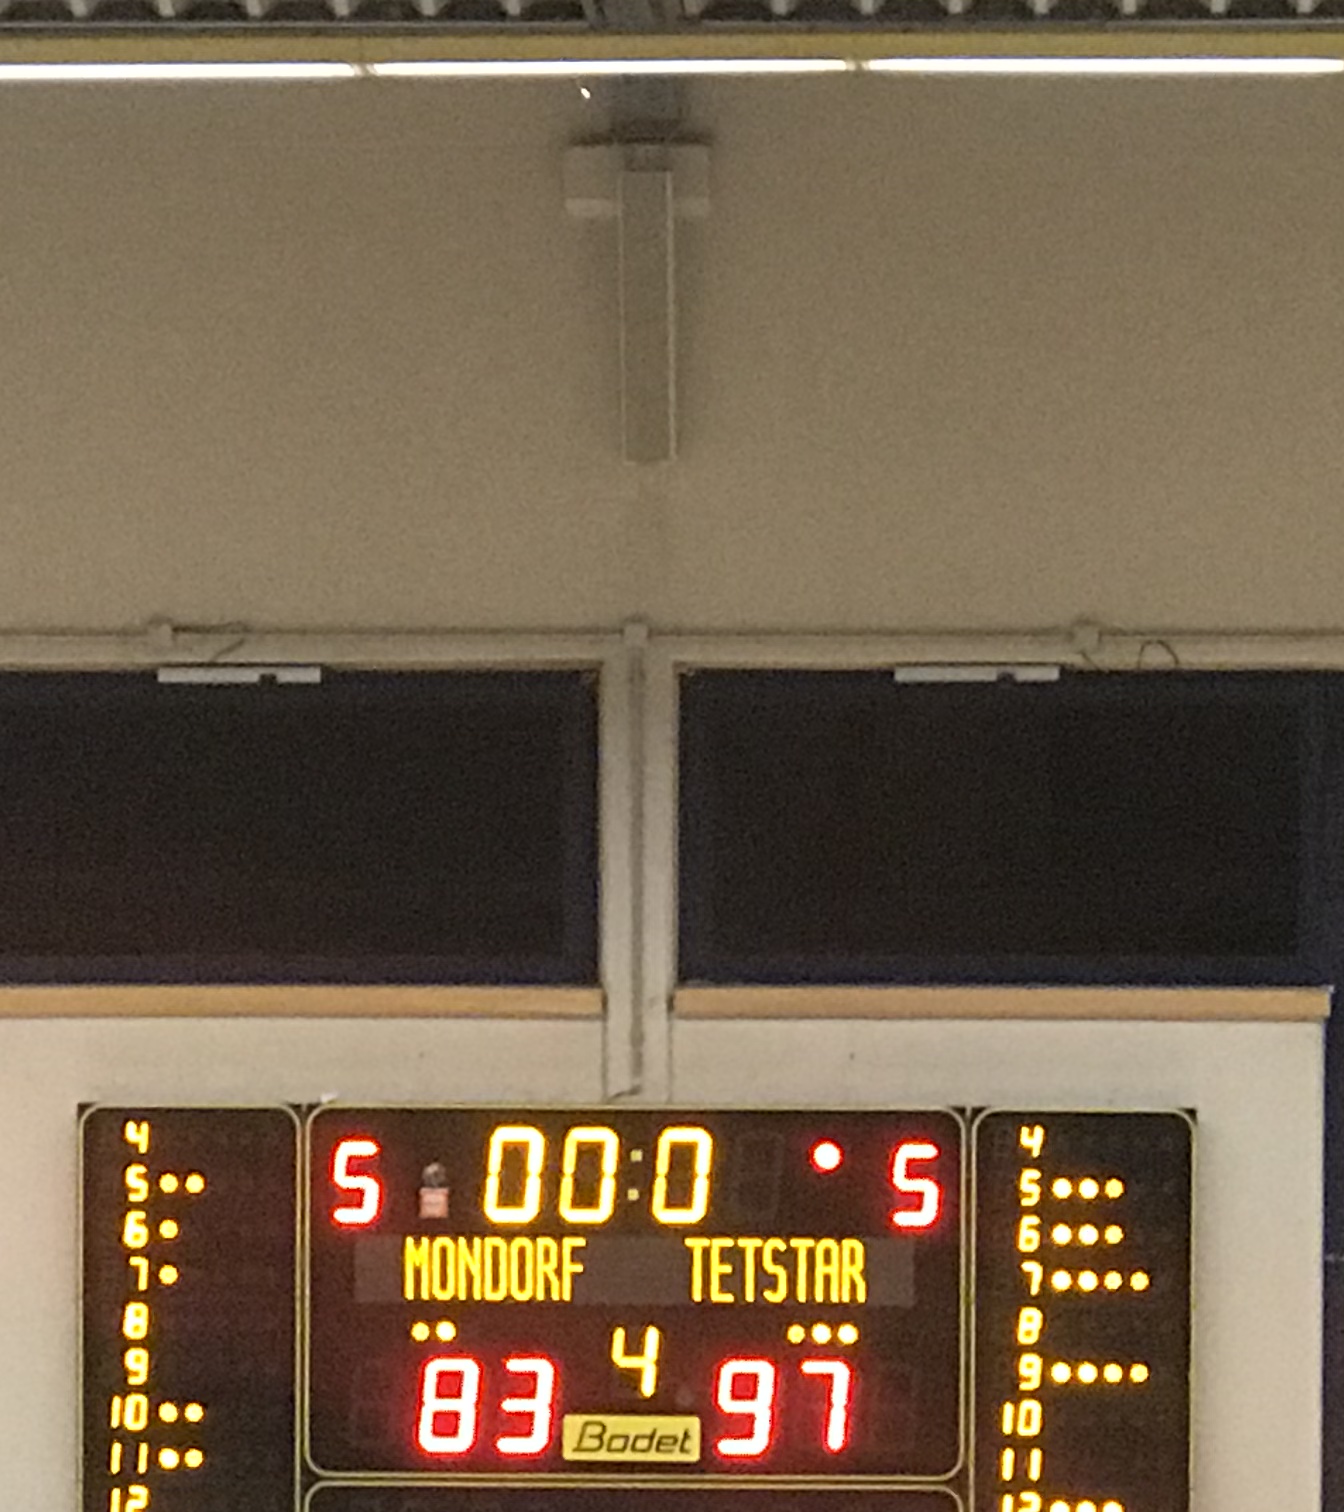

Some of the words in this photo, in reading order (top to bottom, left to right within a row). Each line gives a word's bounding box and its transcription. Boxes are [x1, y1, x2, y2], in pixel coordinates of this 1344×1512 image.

[125, 1121, 149, 1153] 4
[1020, 1125, 1043, 1157] 4
[125, 1164, 149, 1202] 5
[333, 1141, 380, 1226] 5
[892, 1145, 939, 1229] 5
[1019, 1168, 1041, 1206] 5
[122, 1209, 149, 1249] 6
[1016, 1214, 1041, 1252] 6
[129, 1256, 149, 1291] 7
[405, 1236, 586, 1301] MONDORF
[685, 1237, 866, 1303] TETSTAR
[1021, 1260, 1043, 1295] 7
[123, 1302, 149, 1340] 8
[1016, 1307, 1043, 1345] 8
[124, 1347, 149, 1385] 9
[612, 1325, 659, 1399] 4
[1018, 1353, 1043, 1391] 9
[111, 1393, 148, 1432] 10
[417, 1357, 556, 1456] 83
[716, 1360, 851, 1458] 97
[1002, 1398, 1042, 1437] 10
[572, 1420, 691, 1454] Bodet
[111, 1442, 148, 1474] 11
[1001, 1448, 1042, 1481] 11
